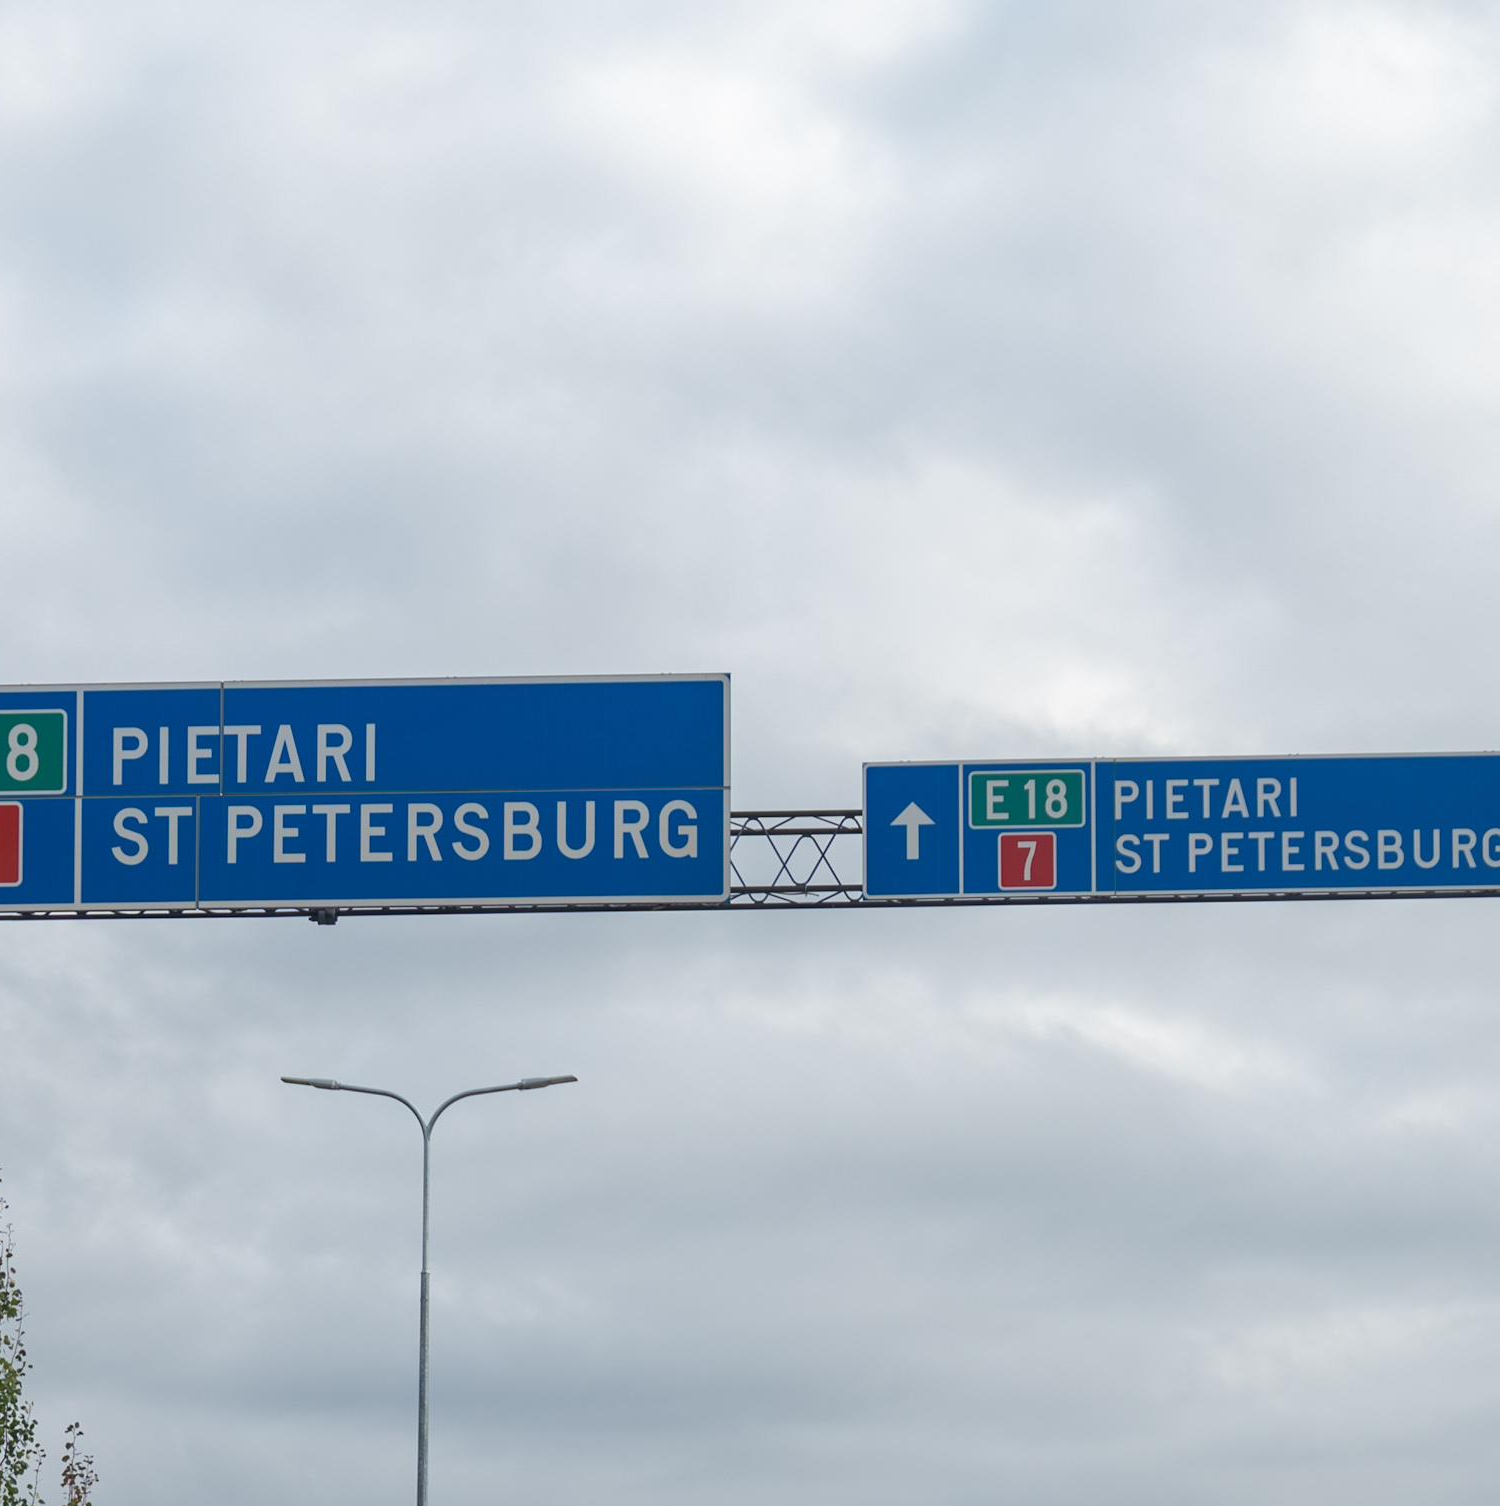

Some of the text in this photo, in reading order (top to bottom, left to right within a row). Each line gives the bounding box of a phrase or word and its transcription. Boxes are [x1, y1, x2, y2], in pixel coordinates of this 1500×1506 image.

[112, 723, 377, 786] PIETARI
[1114, 777, 1298, 820] PIETARI
[112, 799, 699, 866] ST PETERSBURG
[1115, 834, 1170, 874] ST
[1016, 840, 1038, 881] 7
